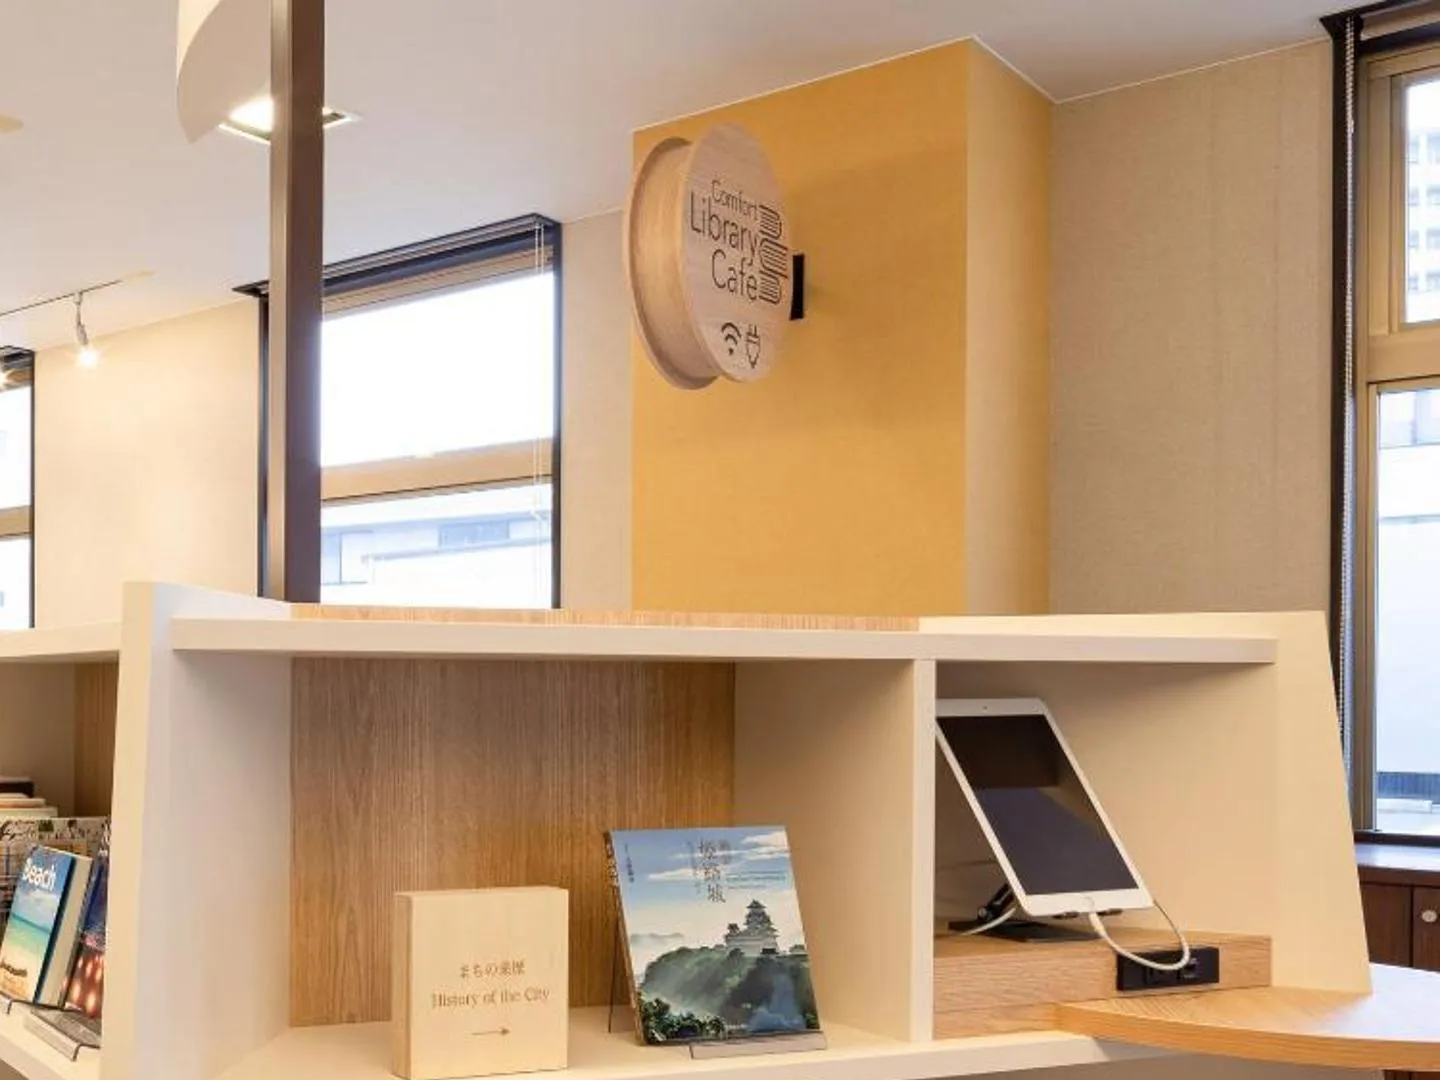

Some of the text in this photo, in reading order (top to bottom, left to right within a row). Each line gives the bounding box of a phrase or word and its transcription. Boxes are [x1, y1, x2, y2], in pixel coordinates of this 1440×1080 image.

[690, 191, 758, 266] Library
[431, 985, 550, 1009] History of the City
